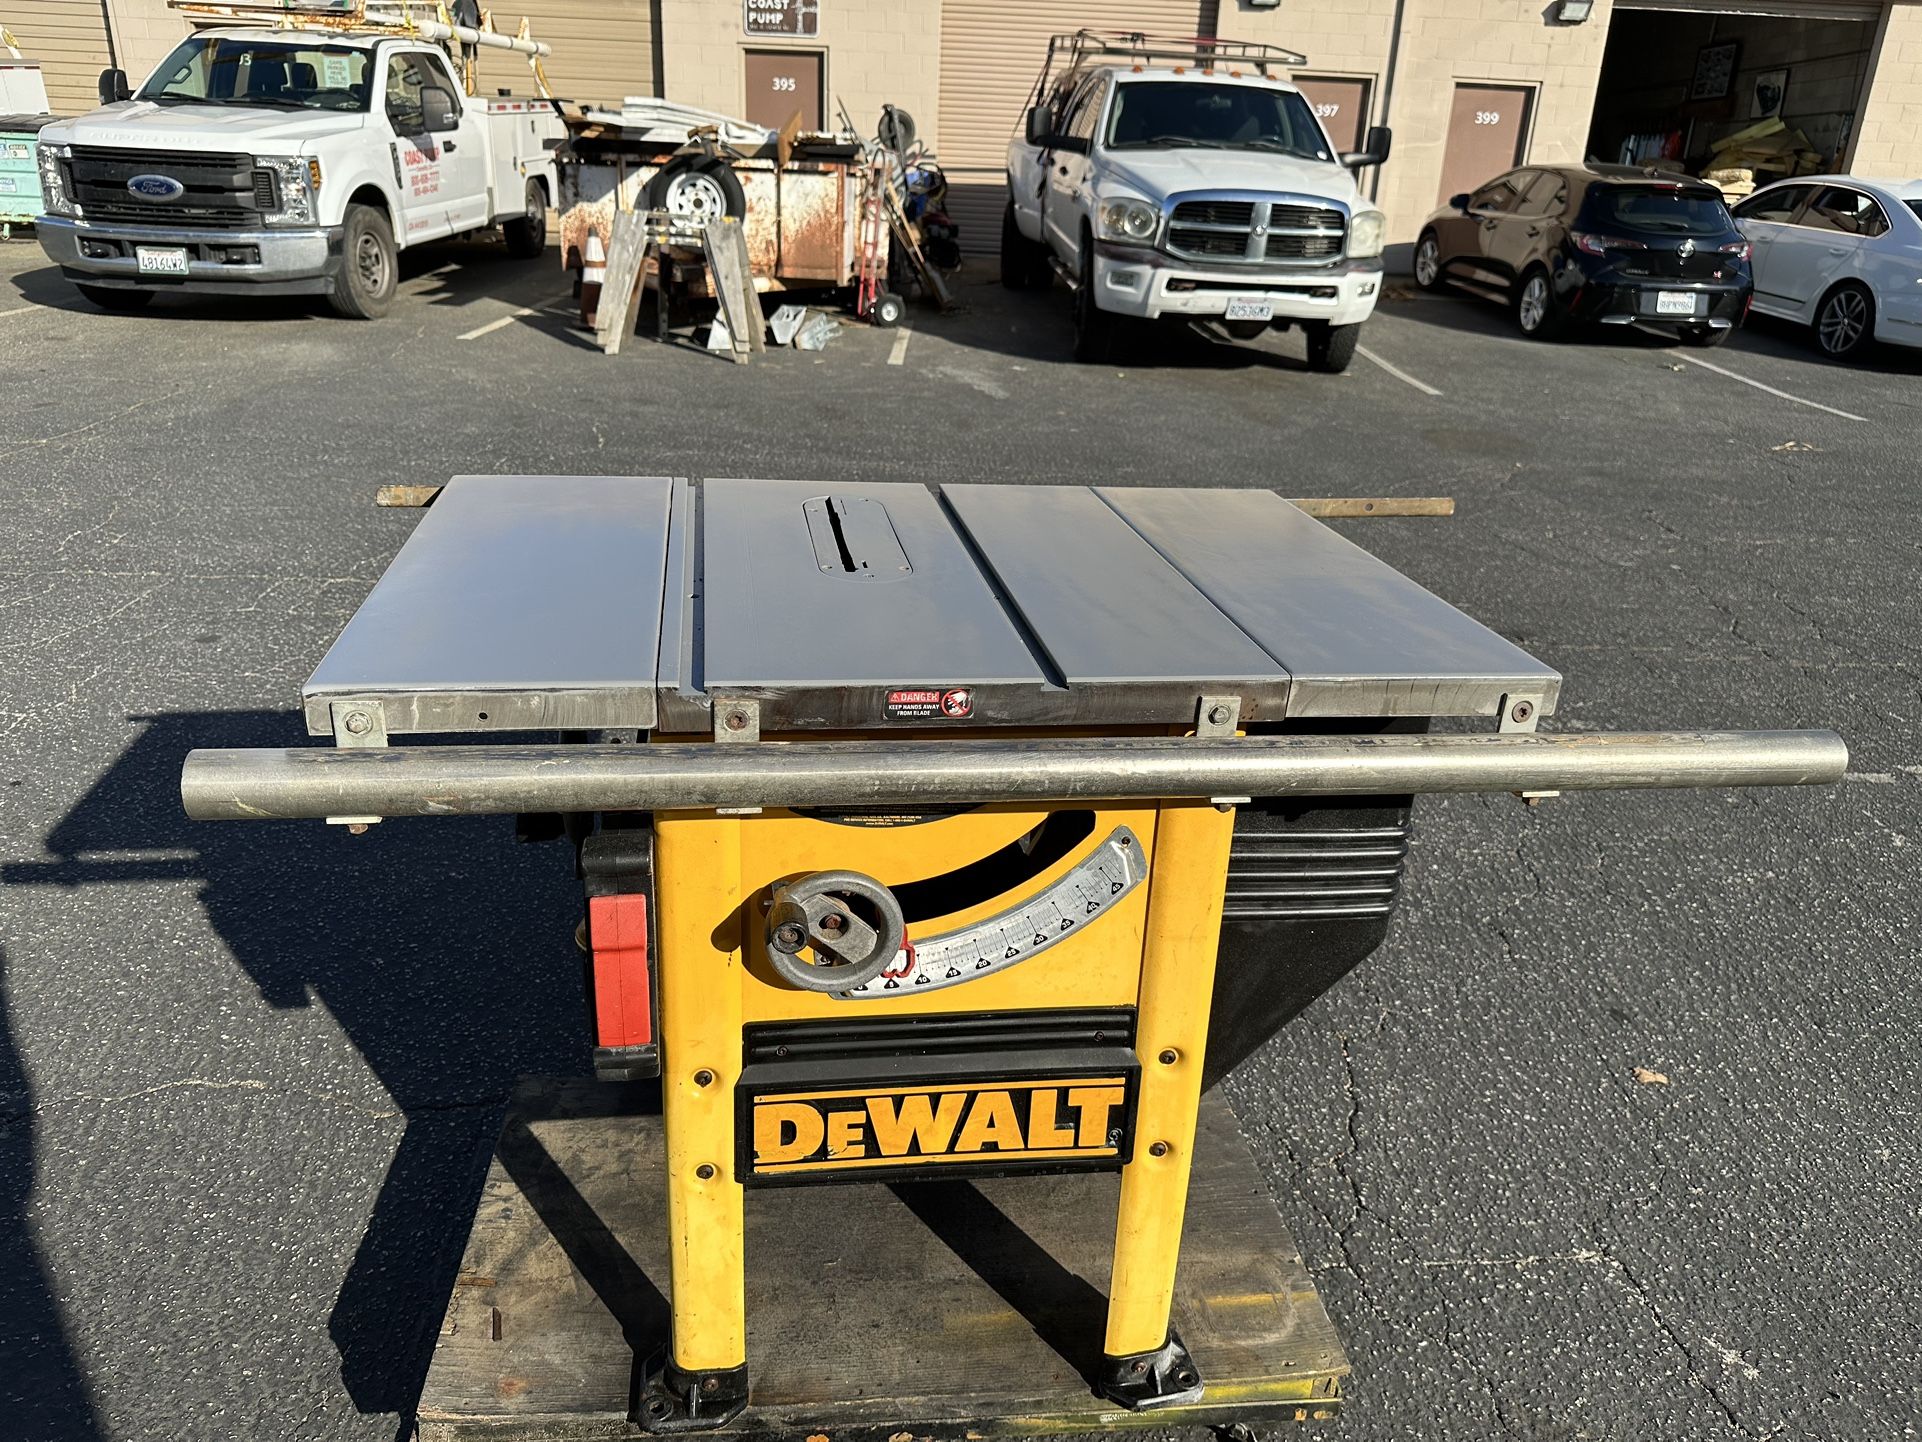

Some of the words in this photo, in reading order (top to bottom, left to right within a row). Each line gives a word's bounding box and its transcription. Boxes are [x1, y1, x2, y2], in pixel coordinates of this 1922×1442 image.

[748, 0, 789, 10] COAST
[748, 11, 784, 24] PUMP
[772, 77, 796, 91] 395
[1315, 103, 1340, 118] 397
[1474, 111, 1500, 125] 399
[141, 181, 167, 194] Ford
[142, 256, 184, 270] 48164W2
[901, 692, 938, 701] DANGER
